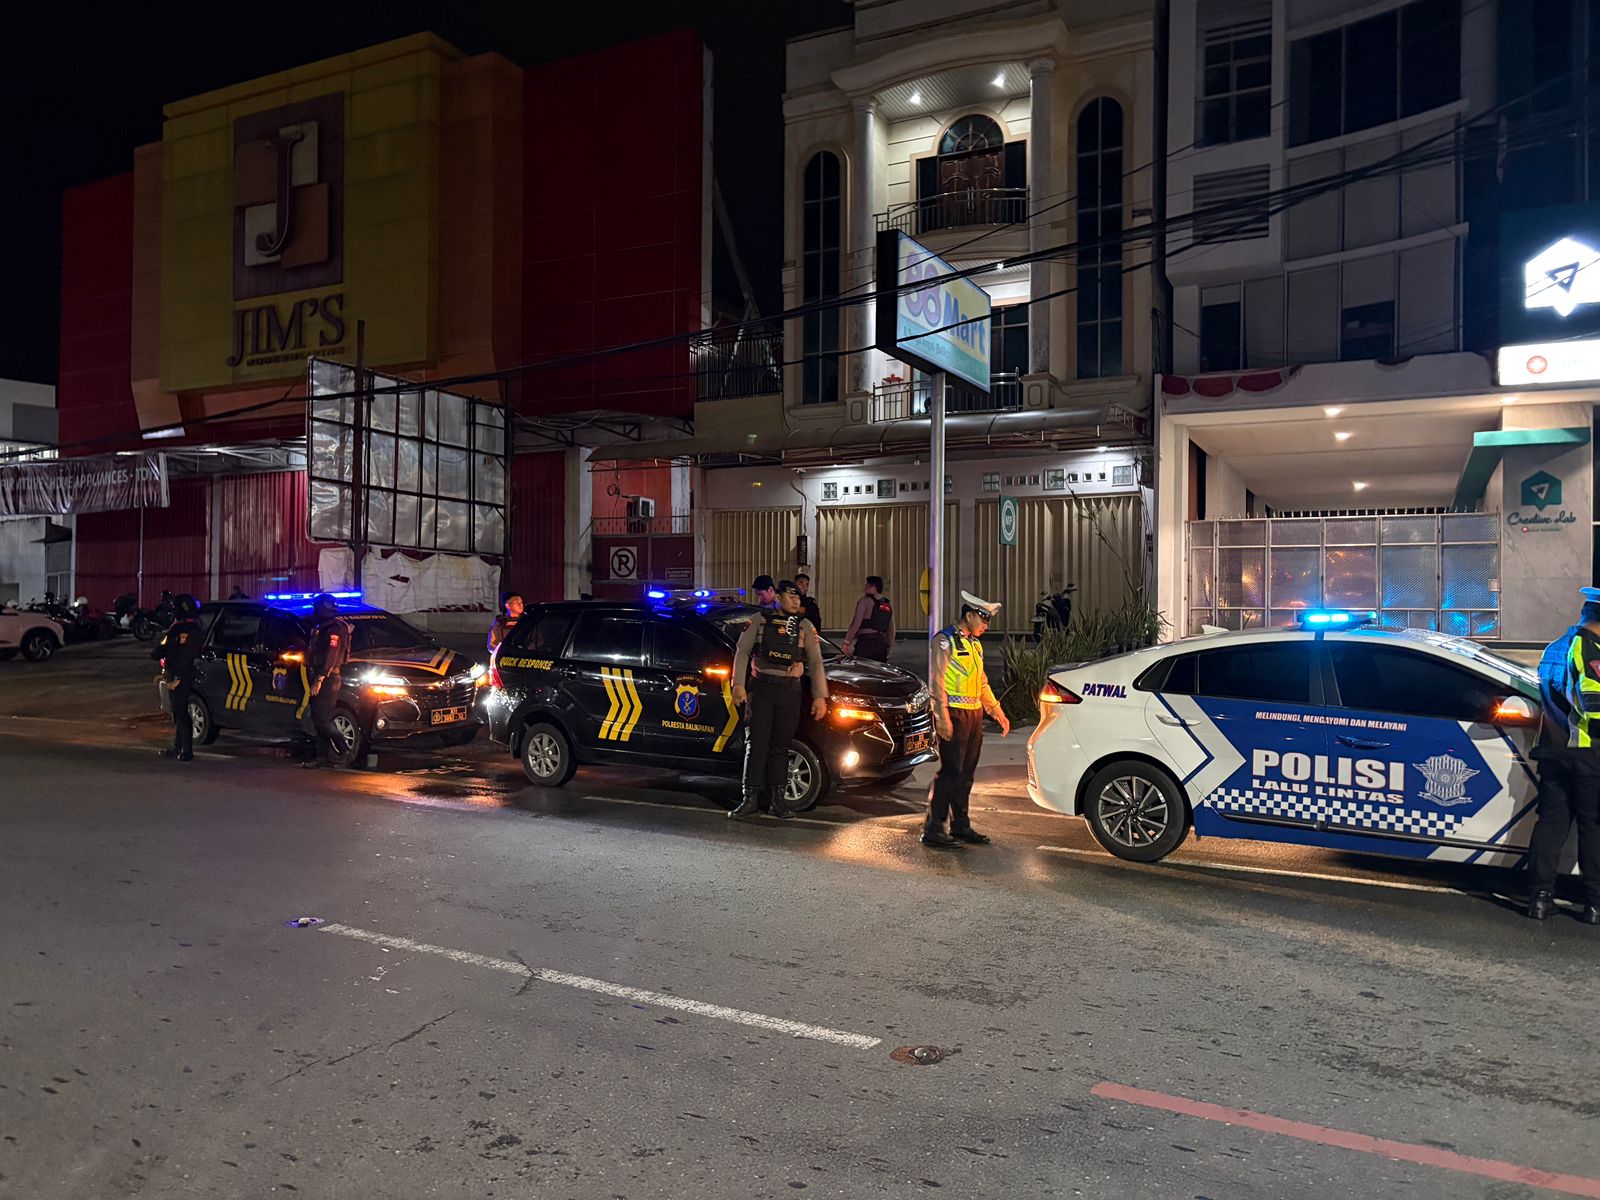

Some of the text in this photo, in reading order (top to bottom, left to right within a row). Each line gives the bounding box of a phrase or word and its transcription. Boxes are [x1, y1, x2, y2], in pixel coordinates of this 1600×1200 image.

[904, 250, 942, 327] 88
[943, 291, 986, 356] Mart
[227, 293, 345, 367] JIM'S
[1507, 510, 1576, 525] Creative Lab
[518, 658, 554, 671] RESPONSE
[1081, 683, 1127, 699] PATWAL
[661, 719, 715, 733] POLRESTA BALIKPAPAN
[1255, 711, 1407, 732] MELINDUNGI, MENGAYOMI DAN MELAYANI
[1252, 748, 1405, 791] POLISI
[1252, 779, 1405, 804] LALU LINTAS
